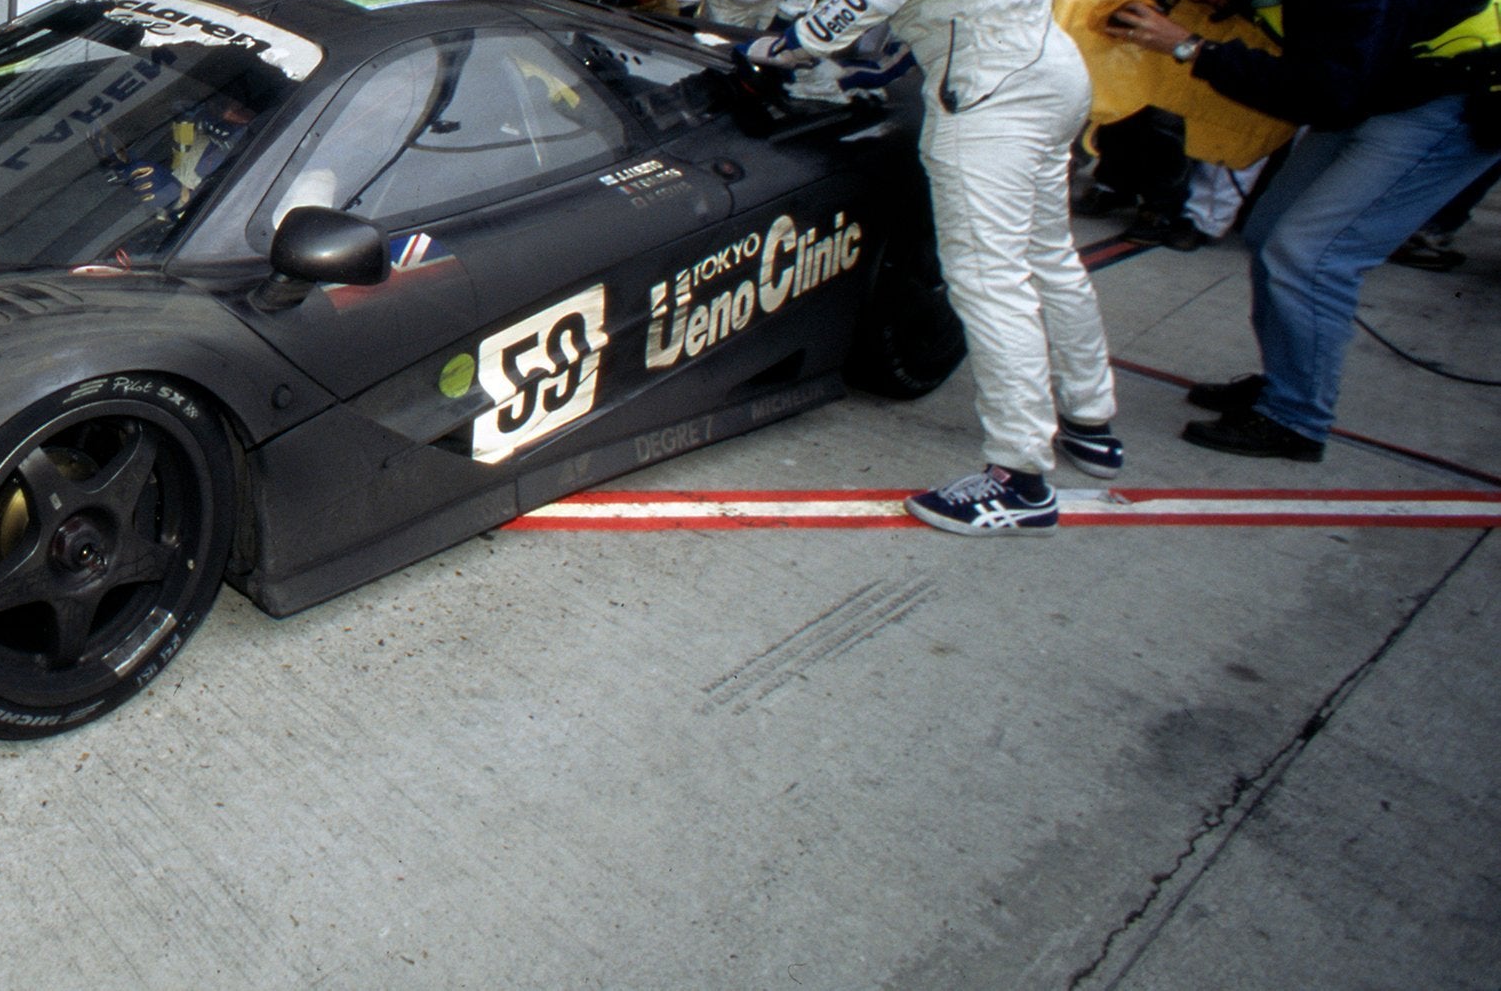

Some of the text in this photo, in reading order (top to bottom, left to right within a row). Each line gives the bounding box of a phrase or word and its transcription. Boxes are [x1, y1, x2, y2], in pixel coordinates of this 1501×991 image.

[806, 8, 856, 42] Ueno
[691, 232, 761, 287] TOKYO
[112, 376, 185, 406] Pilot SX
[497, 312, 593, 435] 59
